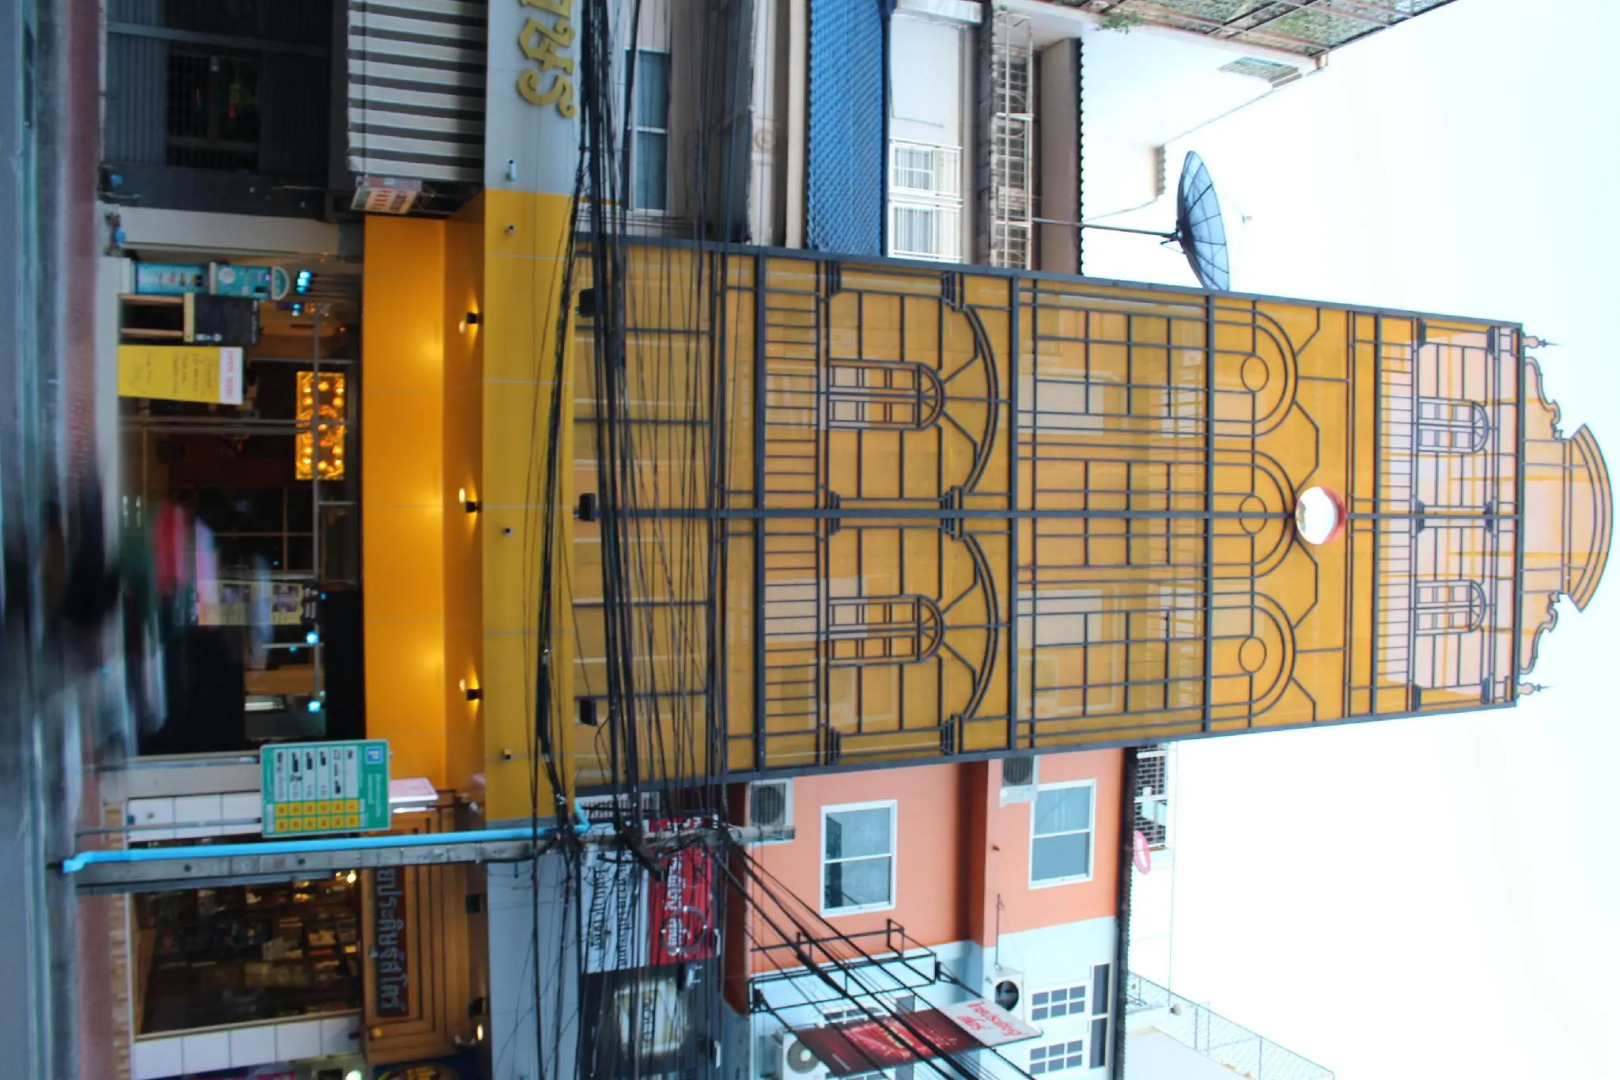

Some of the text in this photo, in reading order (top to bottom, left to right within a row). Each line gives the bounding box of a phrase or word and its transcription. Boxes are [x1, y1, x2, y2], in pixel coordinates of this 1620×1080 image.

[375, 868, 408, 1012] ยประดิษฐ์สโตร์
